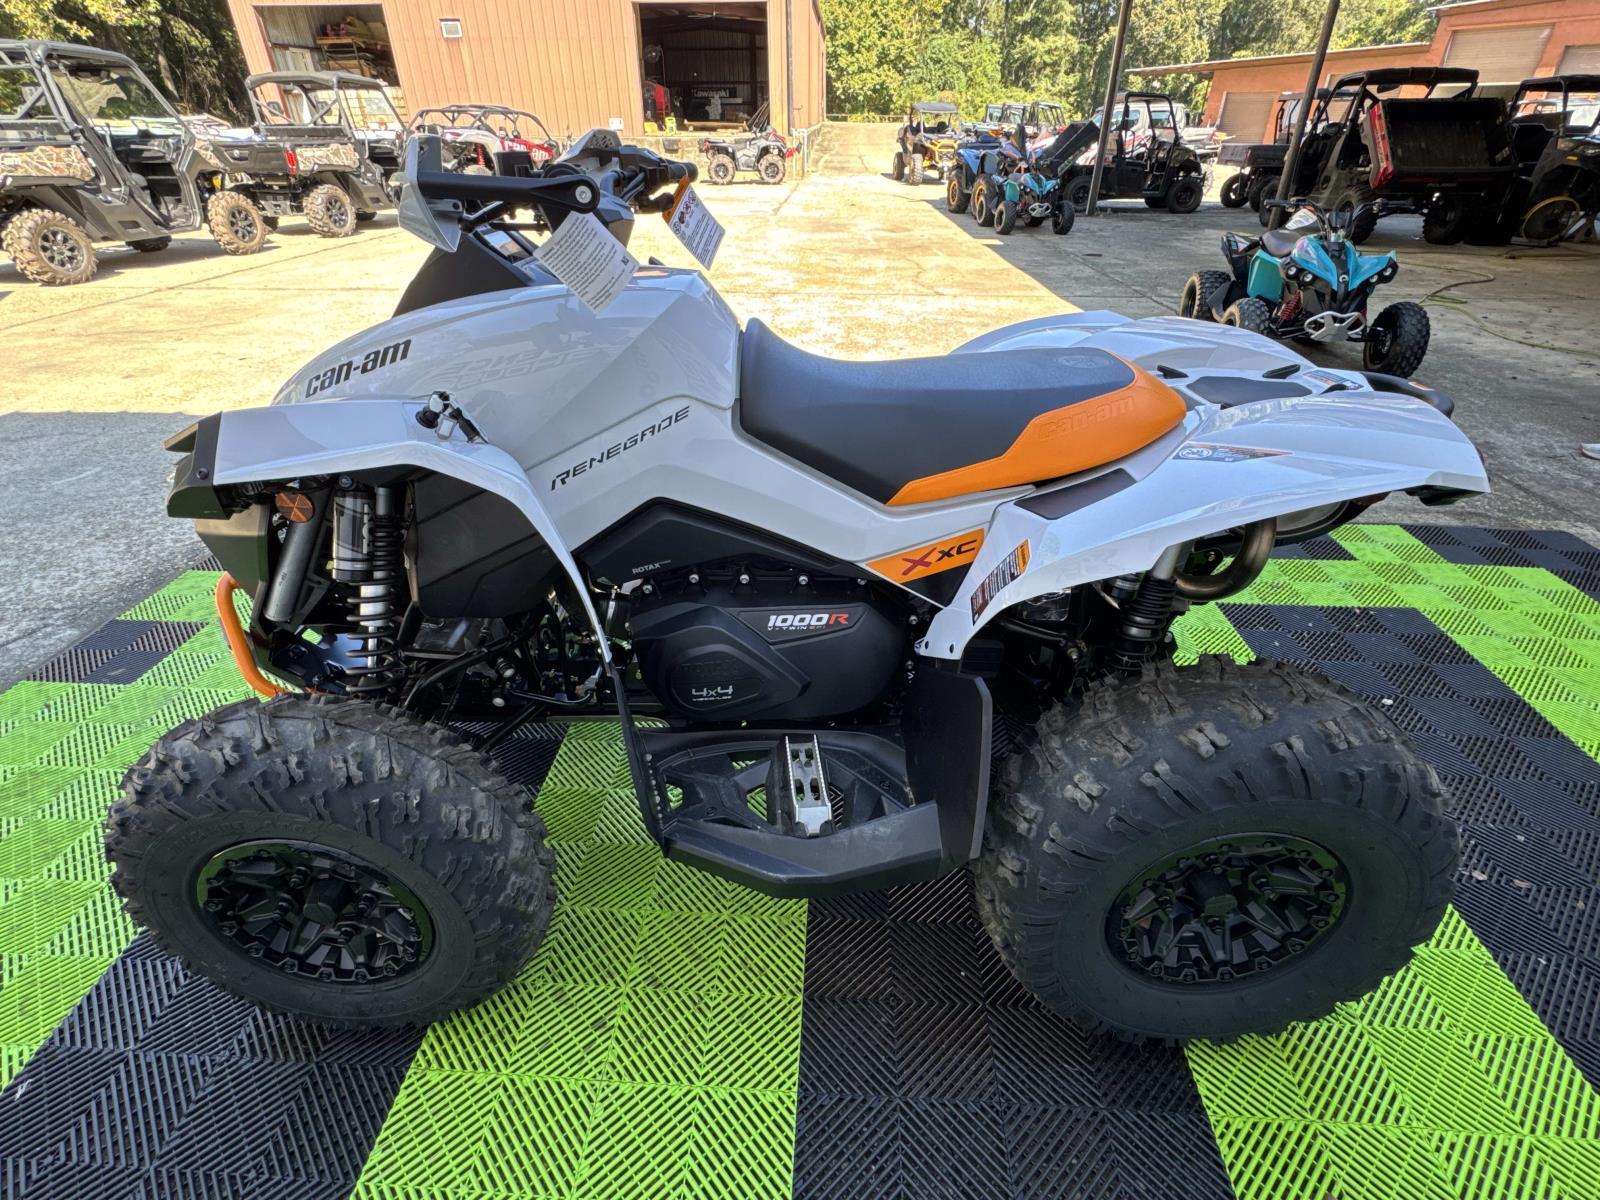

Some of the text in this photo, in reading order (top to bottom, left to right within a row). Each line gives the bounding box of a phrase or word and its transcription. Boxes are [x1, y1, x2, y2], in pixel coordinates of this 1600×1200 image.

[503, 140, 549, 161] canam
[305, 338, 412, 399] can-am
[550, 405, 690, 491] RENEGADE
[631, 561, 661, 574] ROTAX
[767, 613, 849, 627] 1000R
[691, 684, 733, 697] 4x4
